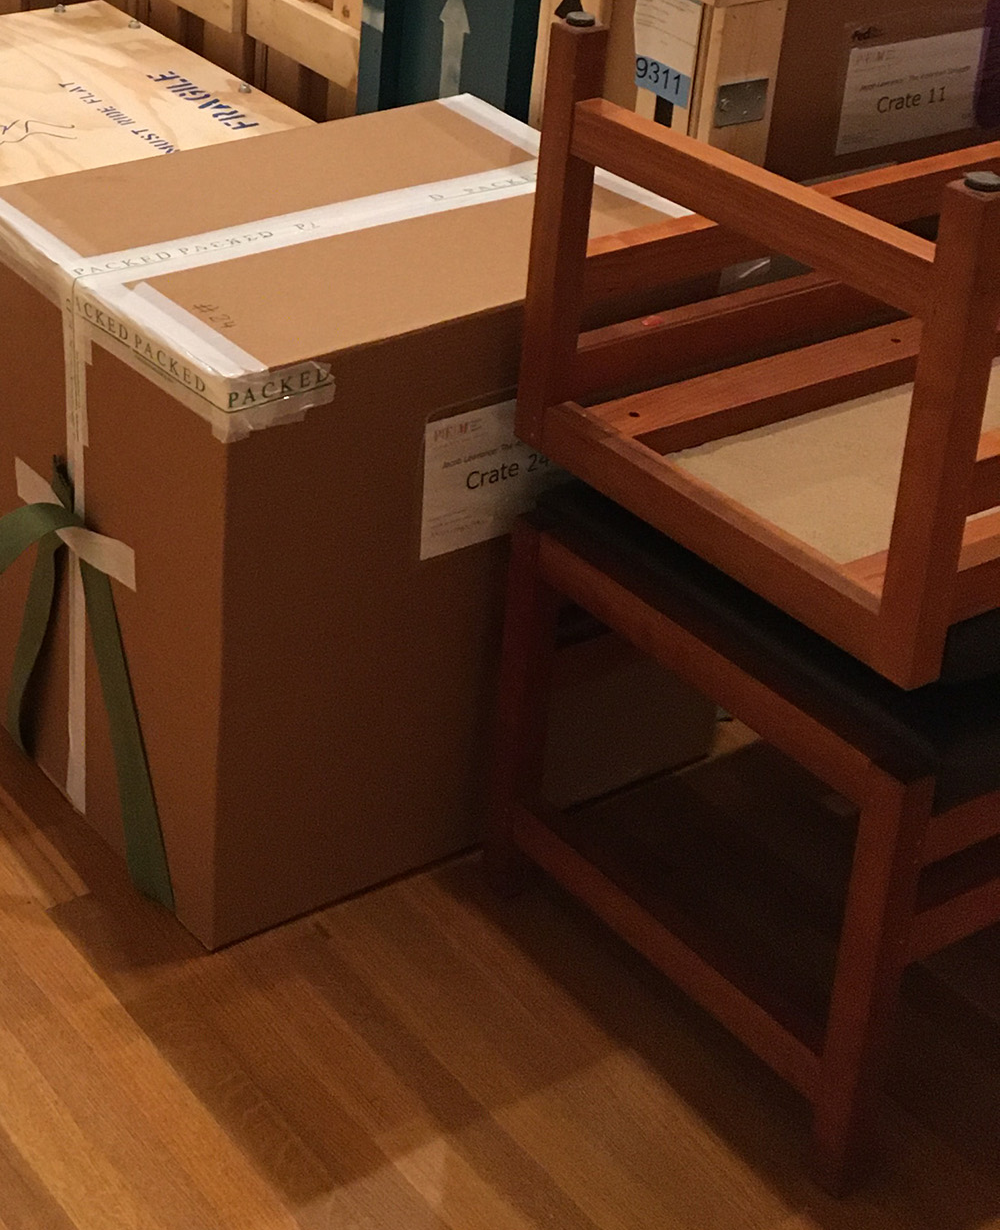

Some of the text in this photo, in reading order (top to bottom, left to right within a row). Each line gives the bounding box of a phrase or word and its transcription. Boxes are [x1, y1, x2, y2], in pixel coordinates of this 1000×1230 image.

[635, 57, 682, 96] 9311
[58, 82, 180, 154] MUST RIDE FLAT
[146, 70, 260, 131] FRAGILE
[876, 86, 946, 114] Crate 11
[73, 250, 172, 276] PACKED
[134, 334, 206, 393] PACKED
[227, 366, 332, 408] PACKED
[465, 453, 550, 490] Crate 24
